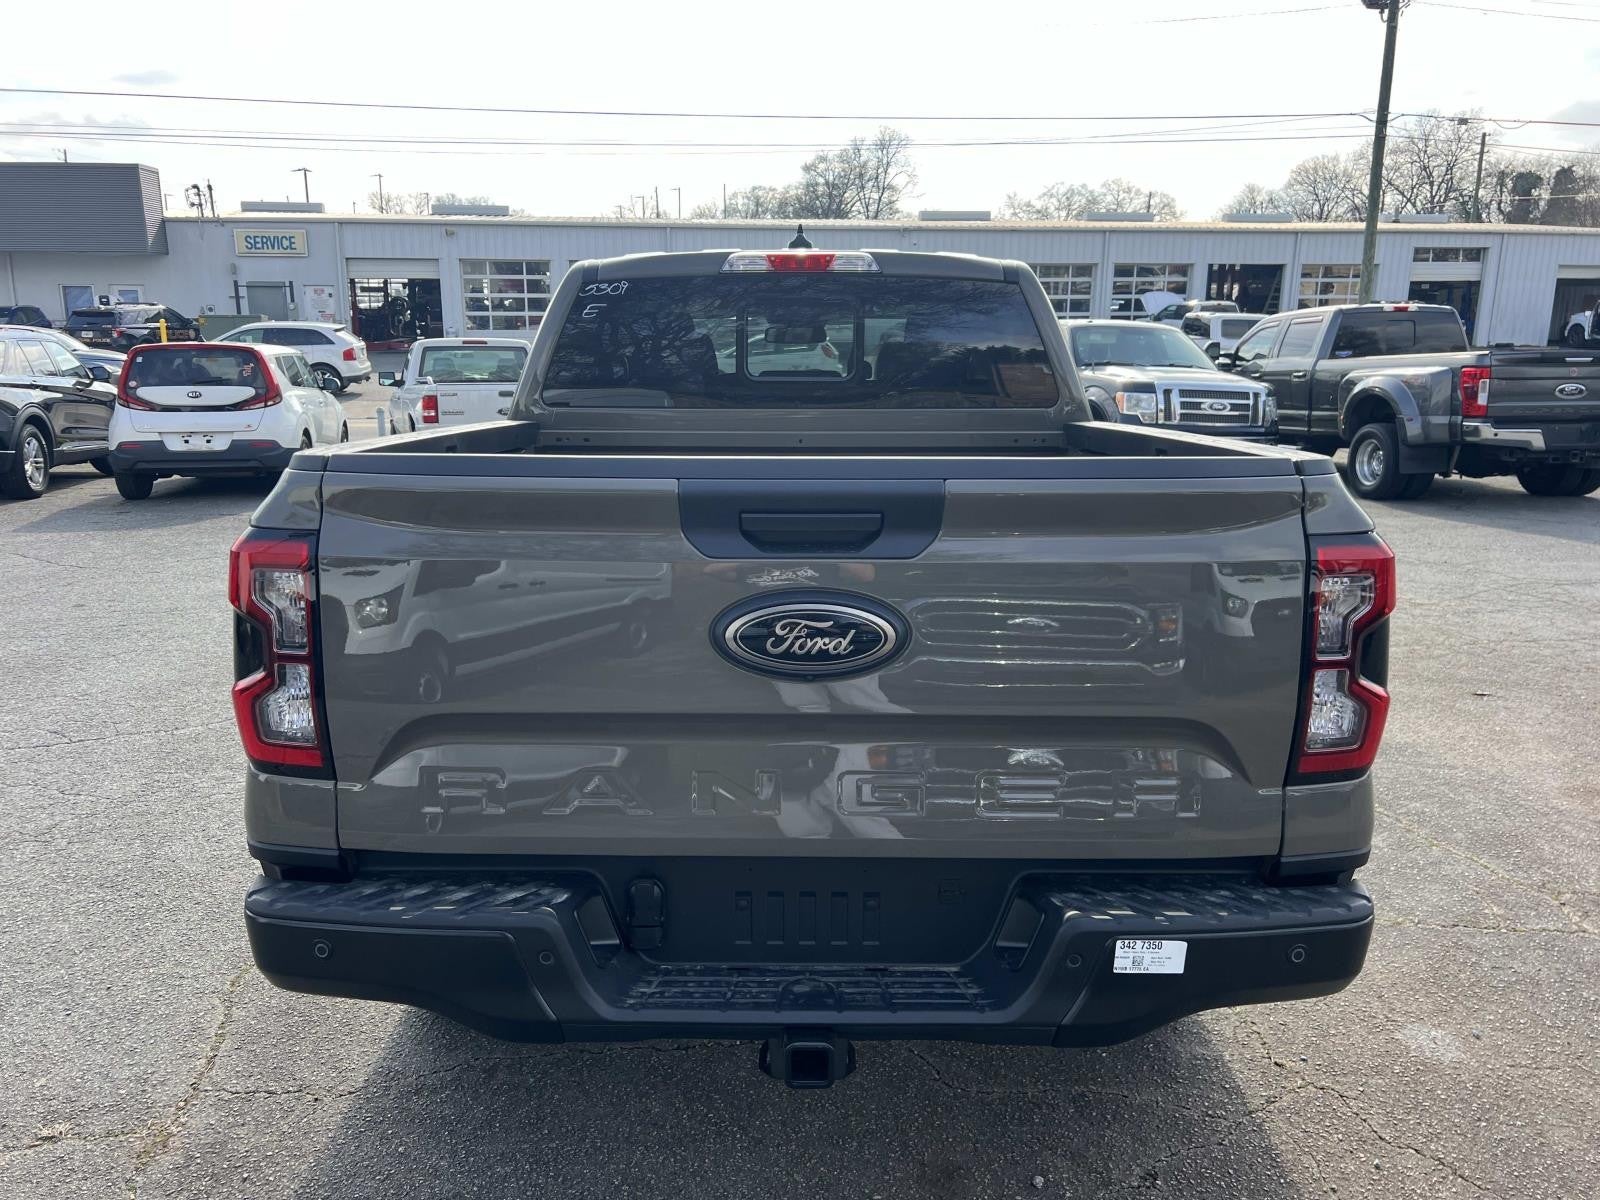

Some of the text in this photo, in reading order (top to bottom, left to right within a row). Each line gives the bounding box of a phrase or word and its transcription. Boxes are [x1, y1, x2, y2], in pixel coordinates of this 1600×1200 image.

[245, 235, 297, 250] SERVICE
[579, 281, 629, 296] 5309
[582, 303, 607, 318] E
[765, 618, 857, 656] Ford
[418, 765, 1201, 820] RANGER
[1120, 941, 1163, 950] 342 7350
